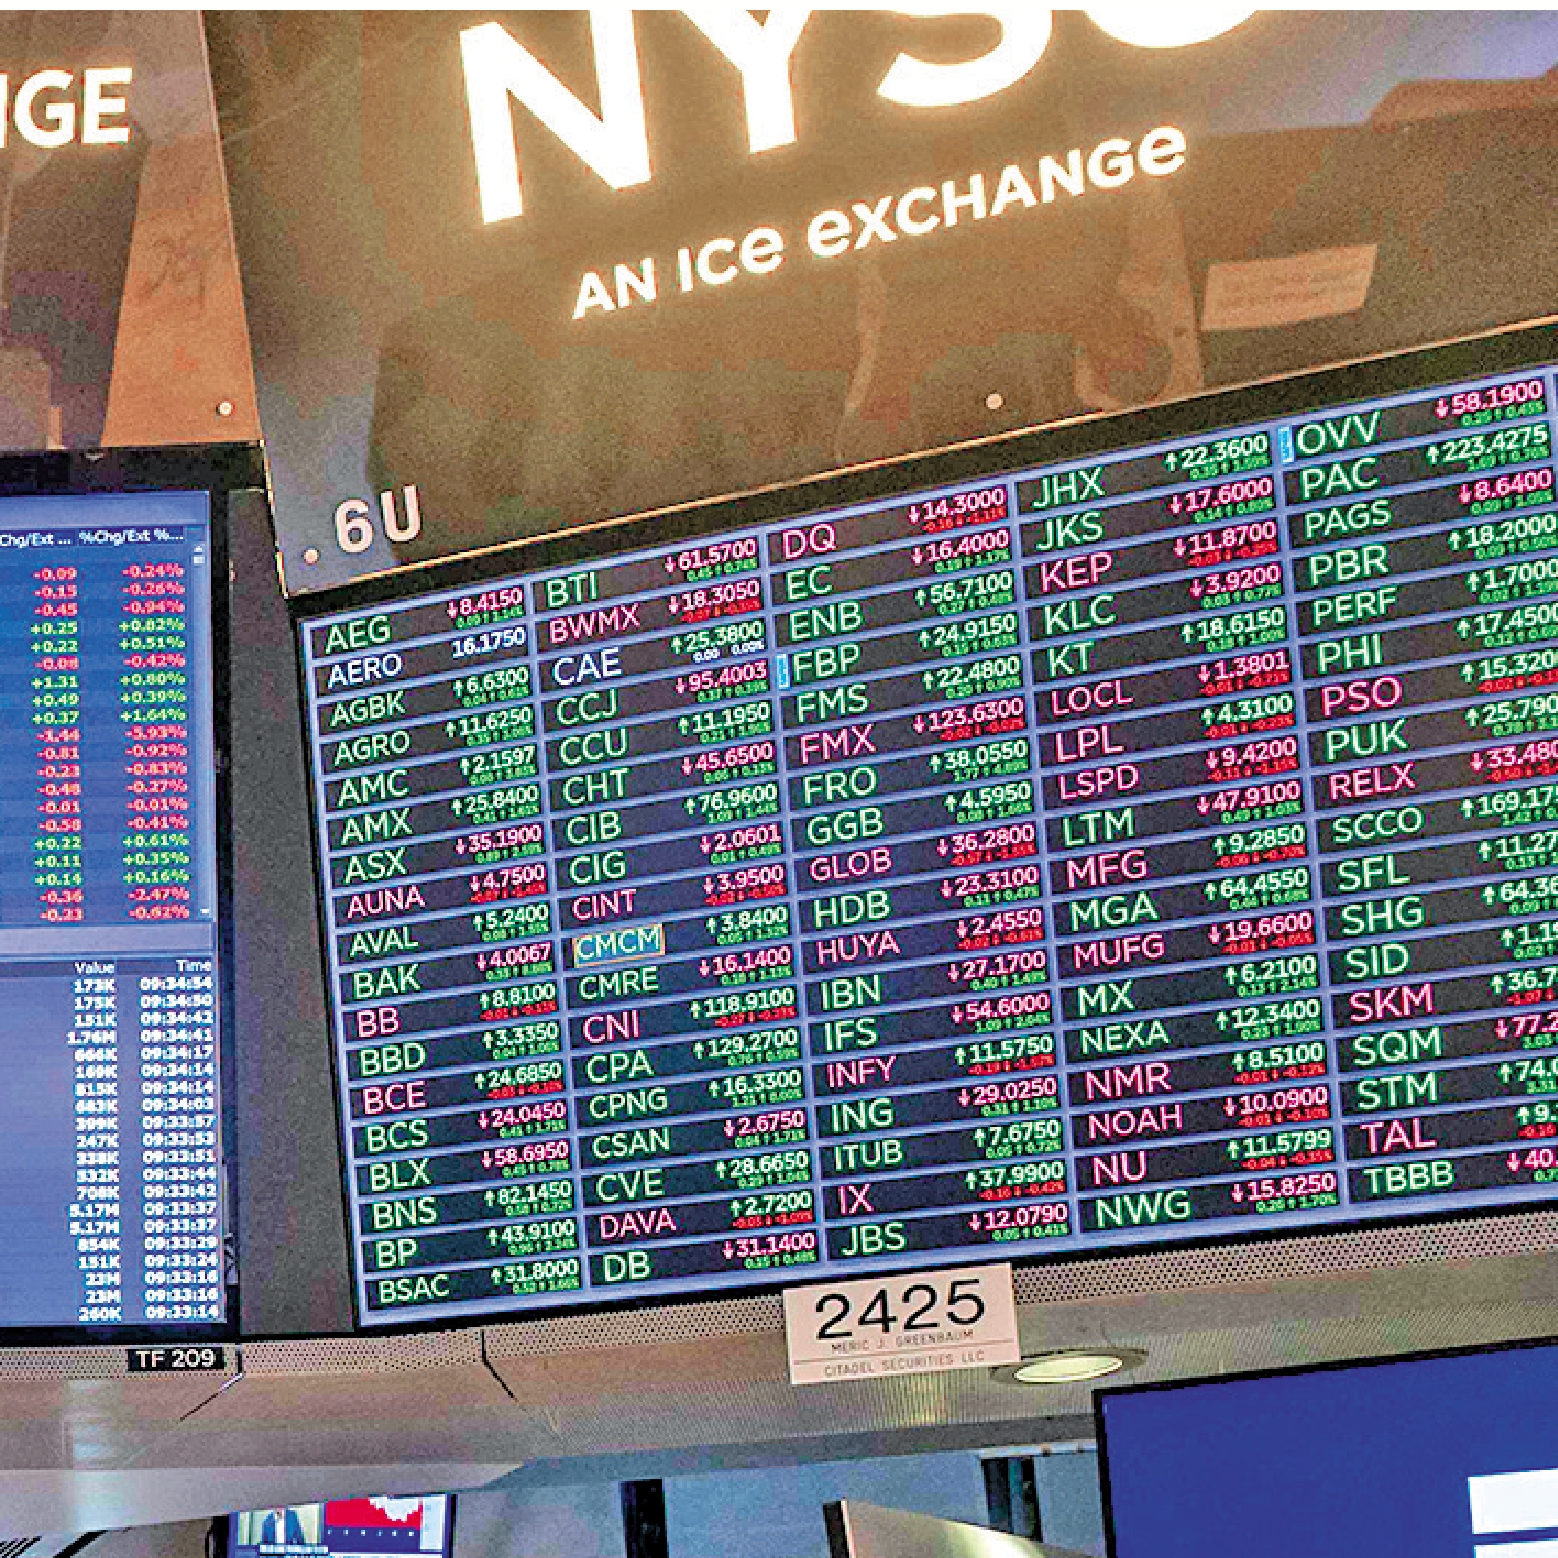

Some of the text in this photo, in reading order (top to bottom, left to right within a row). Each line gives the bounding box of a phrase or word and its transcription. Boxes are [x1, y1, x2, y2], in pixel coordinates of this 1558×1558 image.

[572, 260, 658, 320] AN
[1296, 380, 1543, 455] OVV 58.1900
[1033, 434, 1268, 509] JHX 22.3600
[1301, 424, 1548, 499] PAC 223.4275
[334, 485, 422, 556] 6U
[782, 489, 1006, 560] DQ 14.3000
[547, 539, 758, 607] BTI 61.5700
[325, 588, 523, 654] AEG 8.4150
[1048, 608, 1284, 677] KT 18.6150
[800, 698, 1025, 764] FMX 123.6300
[1327, 718, 1409, 762] PUK
[75, 961, 115, 975] Value
[175, 959, 212, 972] Time
[589, 1071, 802, 1119] CPNG 16.3300
[1358, 1072, 1438, 1111] STM
[1095, 1173, 1336, 1229] NWG 15.8250
[603, 1233, 815, 1282] DB 31.1400
[815, 1278, 985, 1340] 2425
[135, 1348, 214, 1368] TF 209
[824, 1350, 985, 1377] CITADEL SECURITIES LLC
